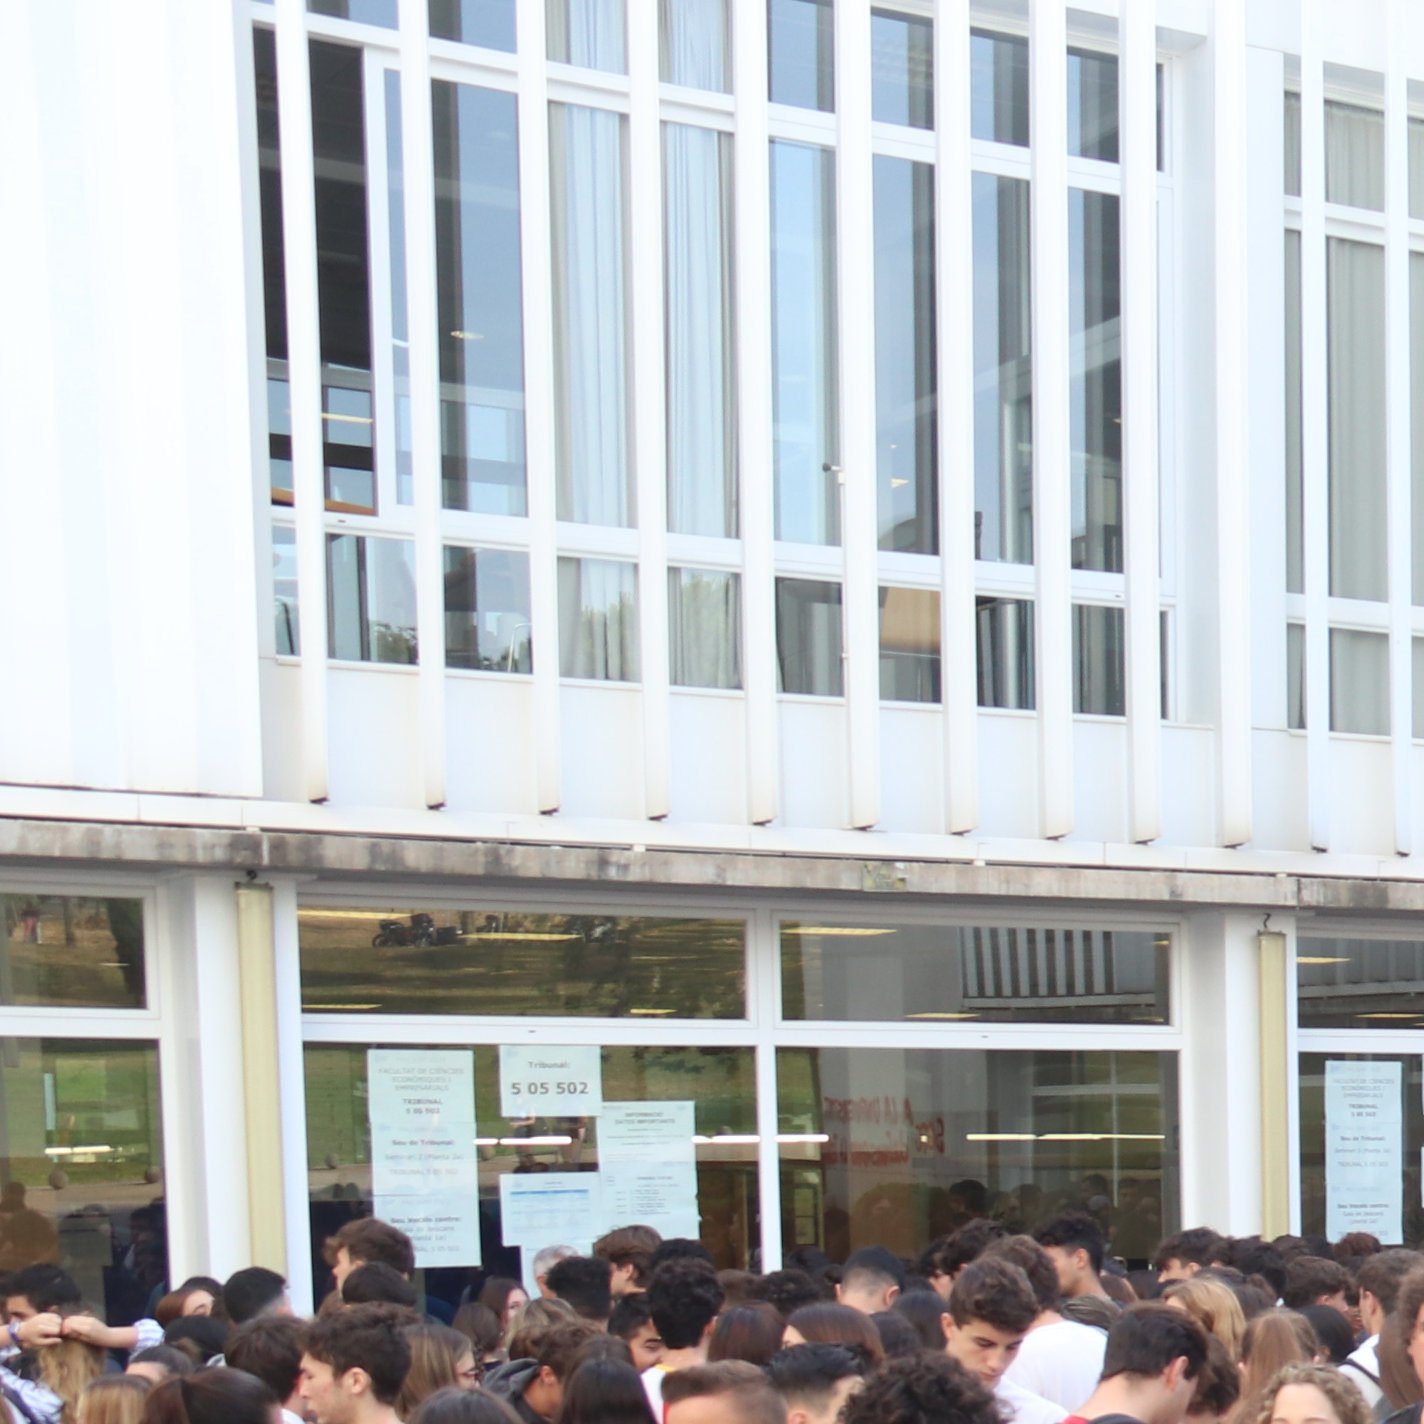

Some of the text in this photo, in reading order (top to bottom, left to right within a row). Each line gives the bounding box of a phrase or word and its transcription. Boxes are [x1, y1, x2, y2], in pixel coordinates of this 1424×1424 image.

[527, 1059, 571, 1071] Tribunal:
[511, 1081, 590, 1096] 5 05 502
